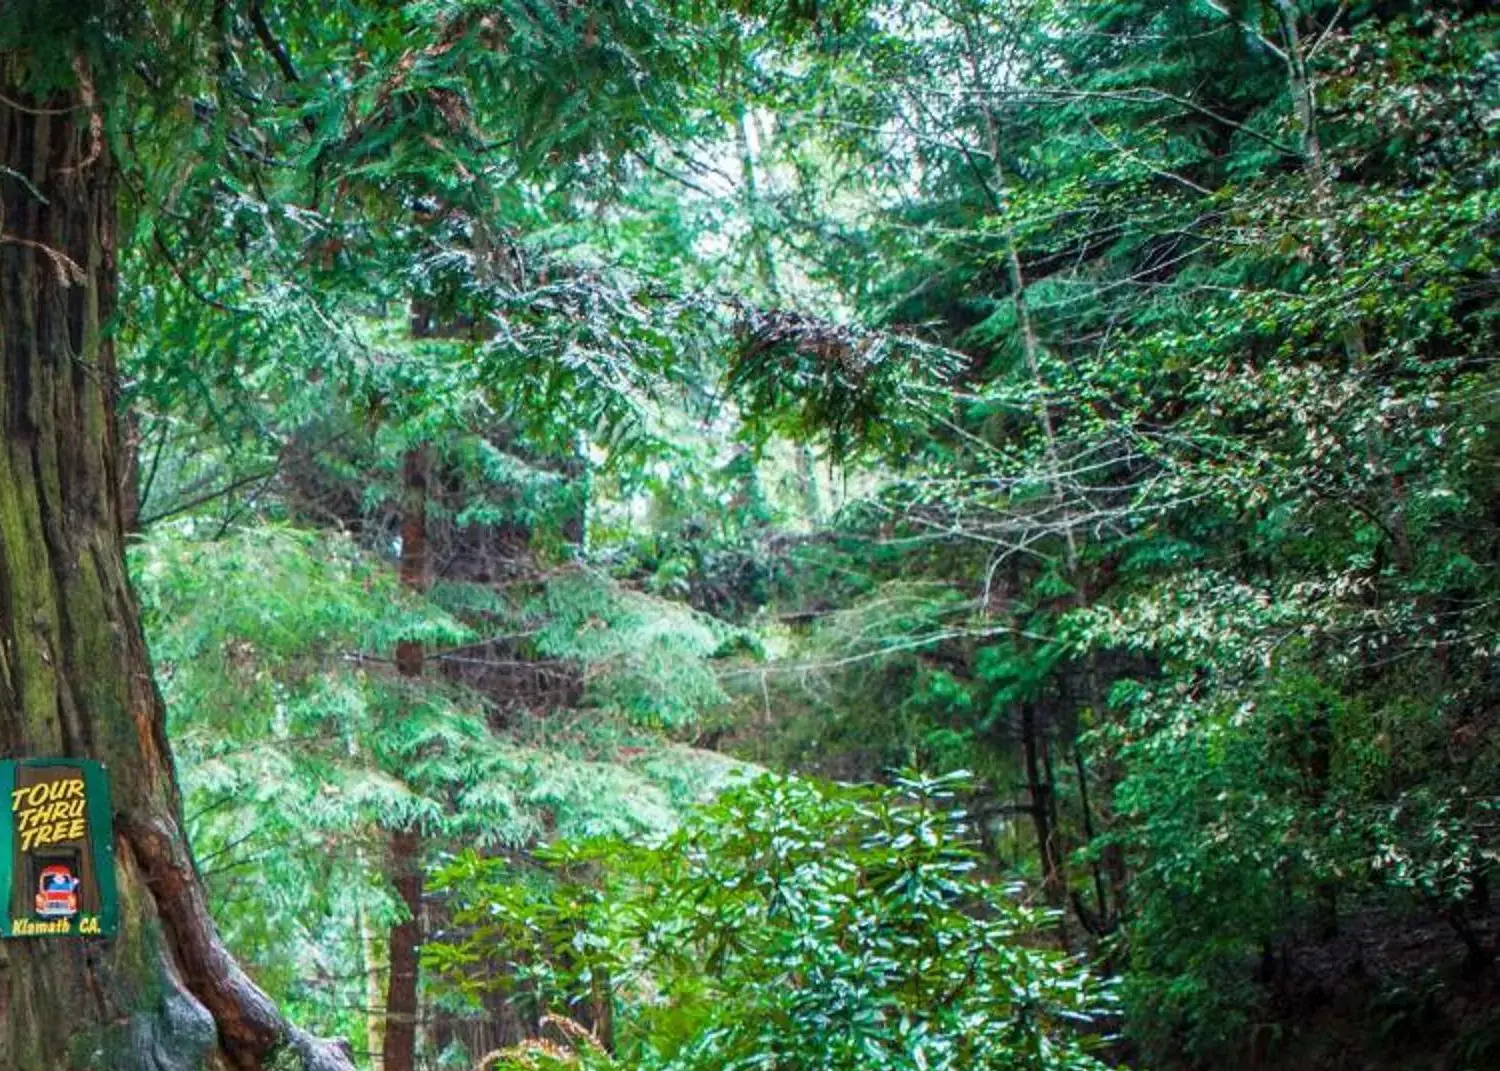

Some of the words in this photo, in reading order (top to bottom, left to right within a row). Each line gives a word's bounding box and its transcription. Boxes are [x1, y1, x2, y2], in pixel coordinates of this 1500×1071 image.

[11, 779, 84, 811] TOUR
[18, 799, 85, 831] THRU
[21, 818, 84, 851] TREE
[12, 917, 70, 935] Klamath
